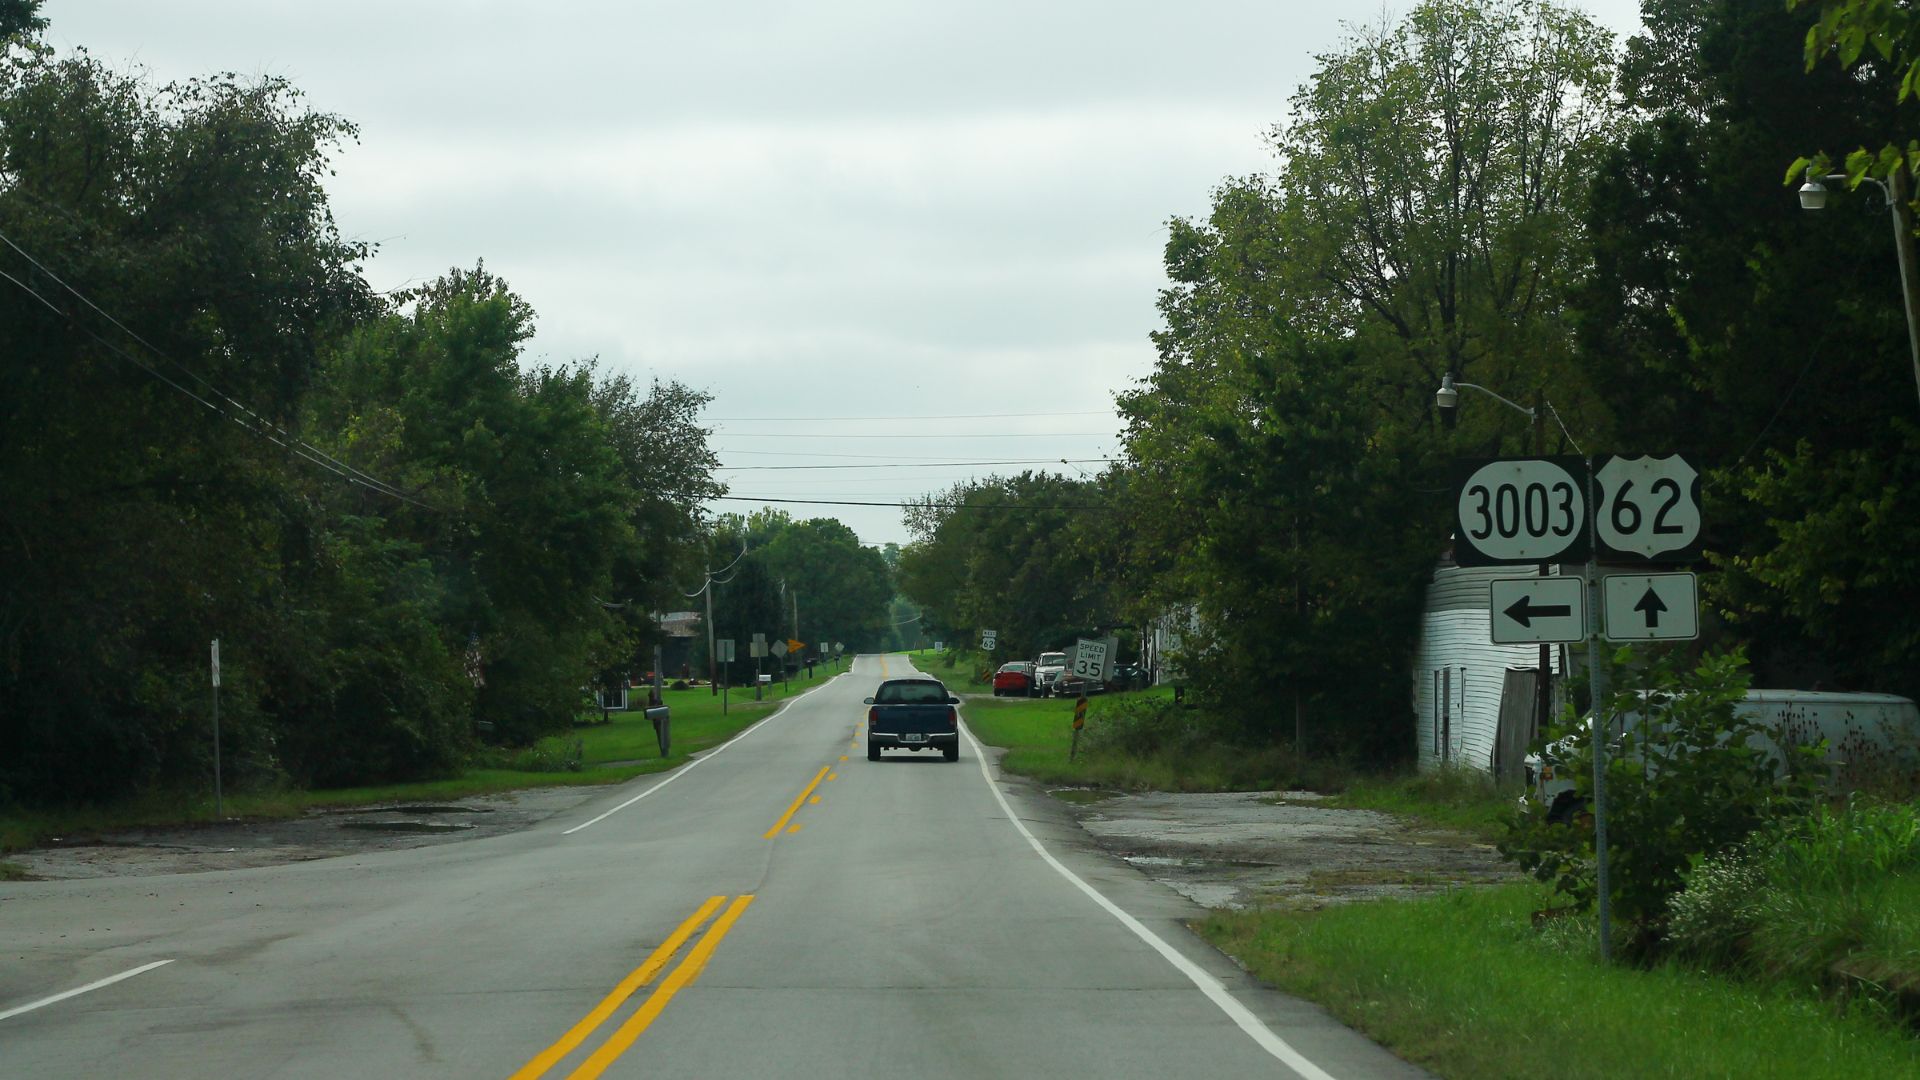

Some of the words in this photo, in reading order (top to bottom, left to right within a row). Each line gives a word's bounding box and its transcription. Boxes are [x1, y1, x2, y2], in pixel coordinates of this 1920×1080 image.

[1468, 482, 1574, 540] 3003
[1611, 478, 1683, 535] 62
[984, 640, 994, 649] 62
[1080, 643, 1104, 653] SPEED
[1080, 652, 1101, 660] LIMIT
[1077, 660, 1100, 677] 35
